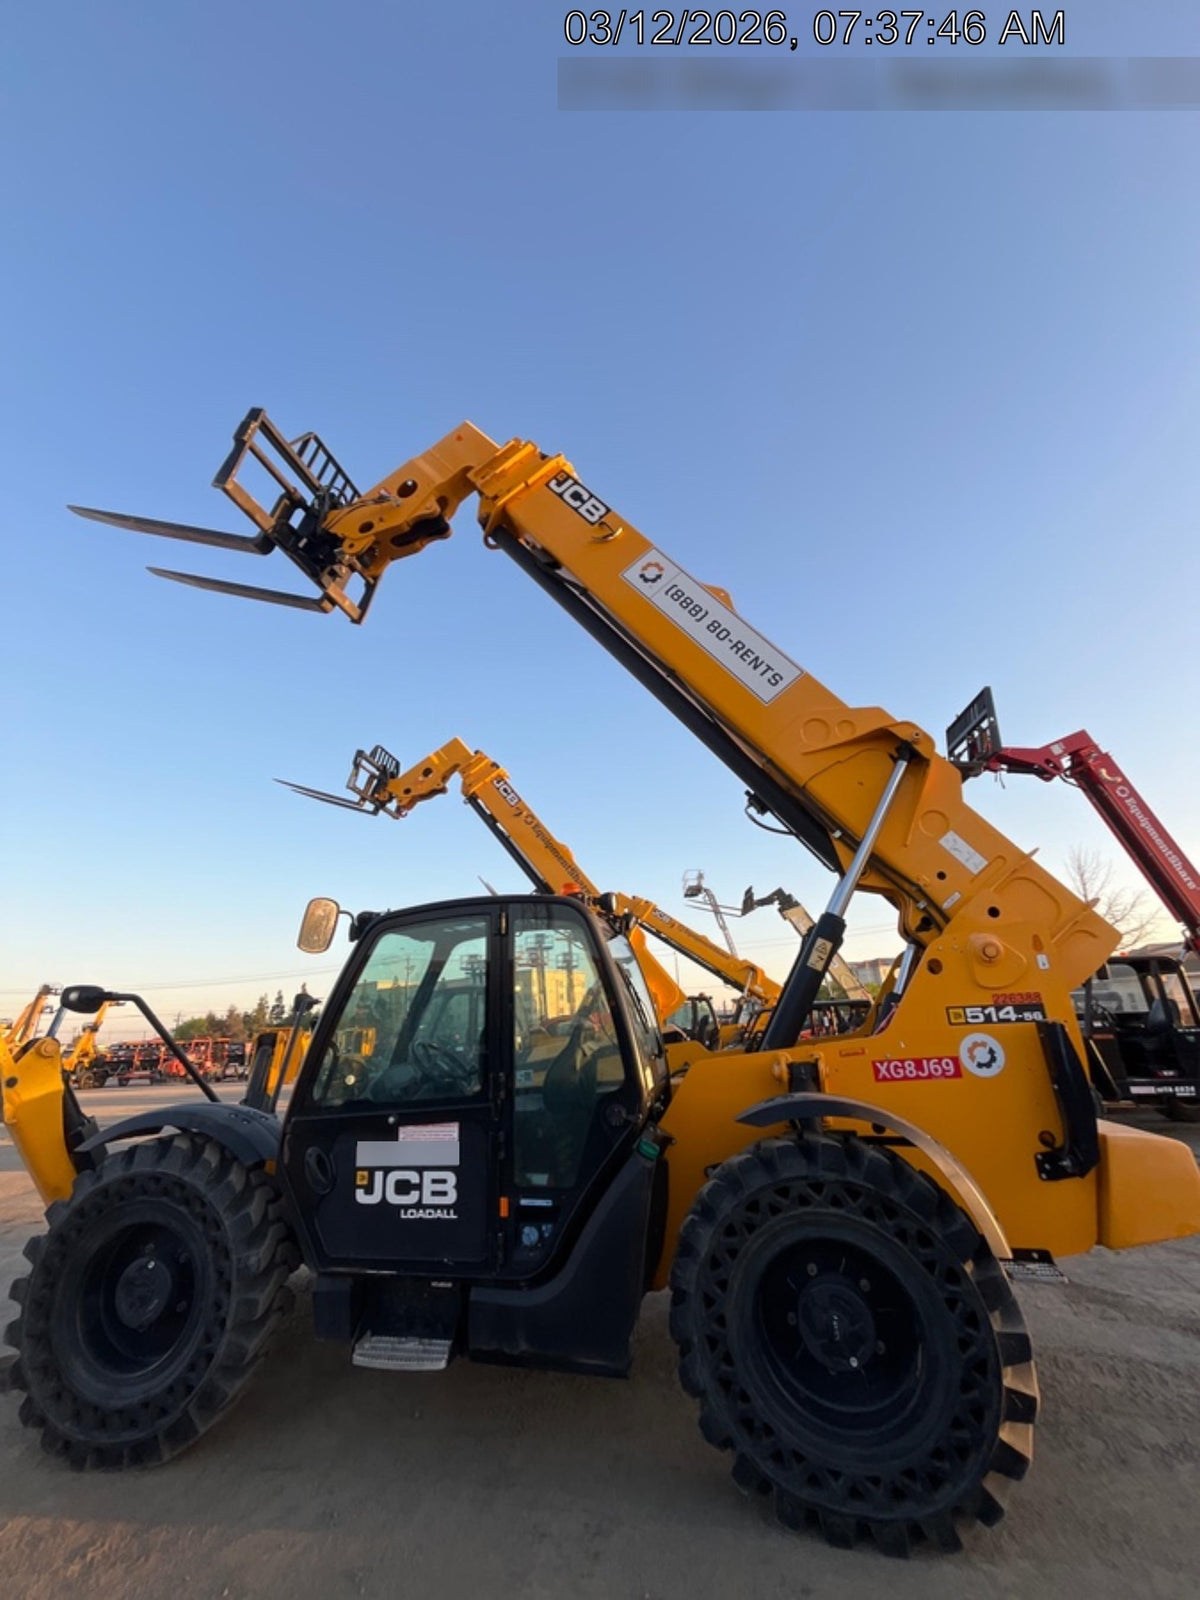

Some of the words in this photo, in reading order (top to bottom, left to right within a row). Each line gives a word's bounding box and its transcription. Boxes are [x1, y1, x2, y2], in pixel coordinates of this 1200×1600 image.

[548, 474, 608, 523] JCB
[664, 583, 709, 623] (888)
[706, 619, 784, 687] 80-RENTS
[494, 779, 519, 806] JCB
[1124, 797, 1196, 889] EquipmentShare
[876, 1058, 955, 1079] XG8J69
[355, 1170, 458, 1205] JCB
[400, 1208, 458, 1219] LOADALL
